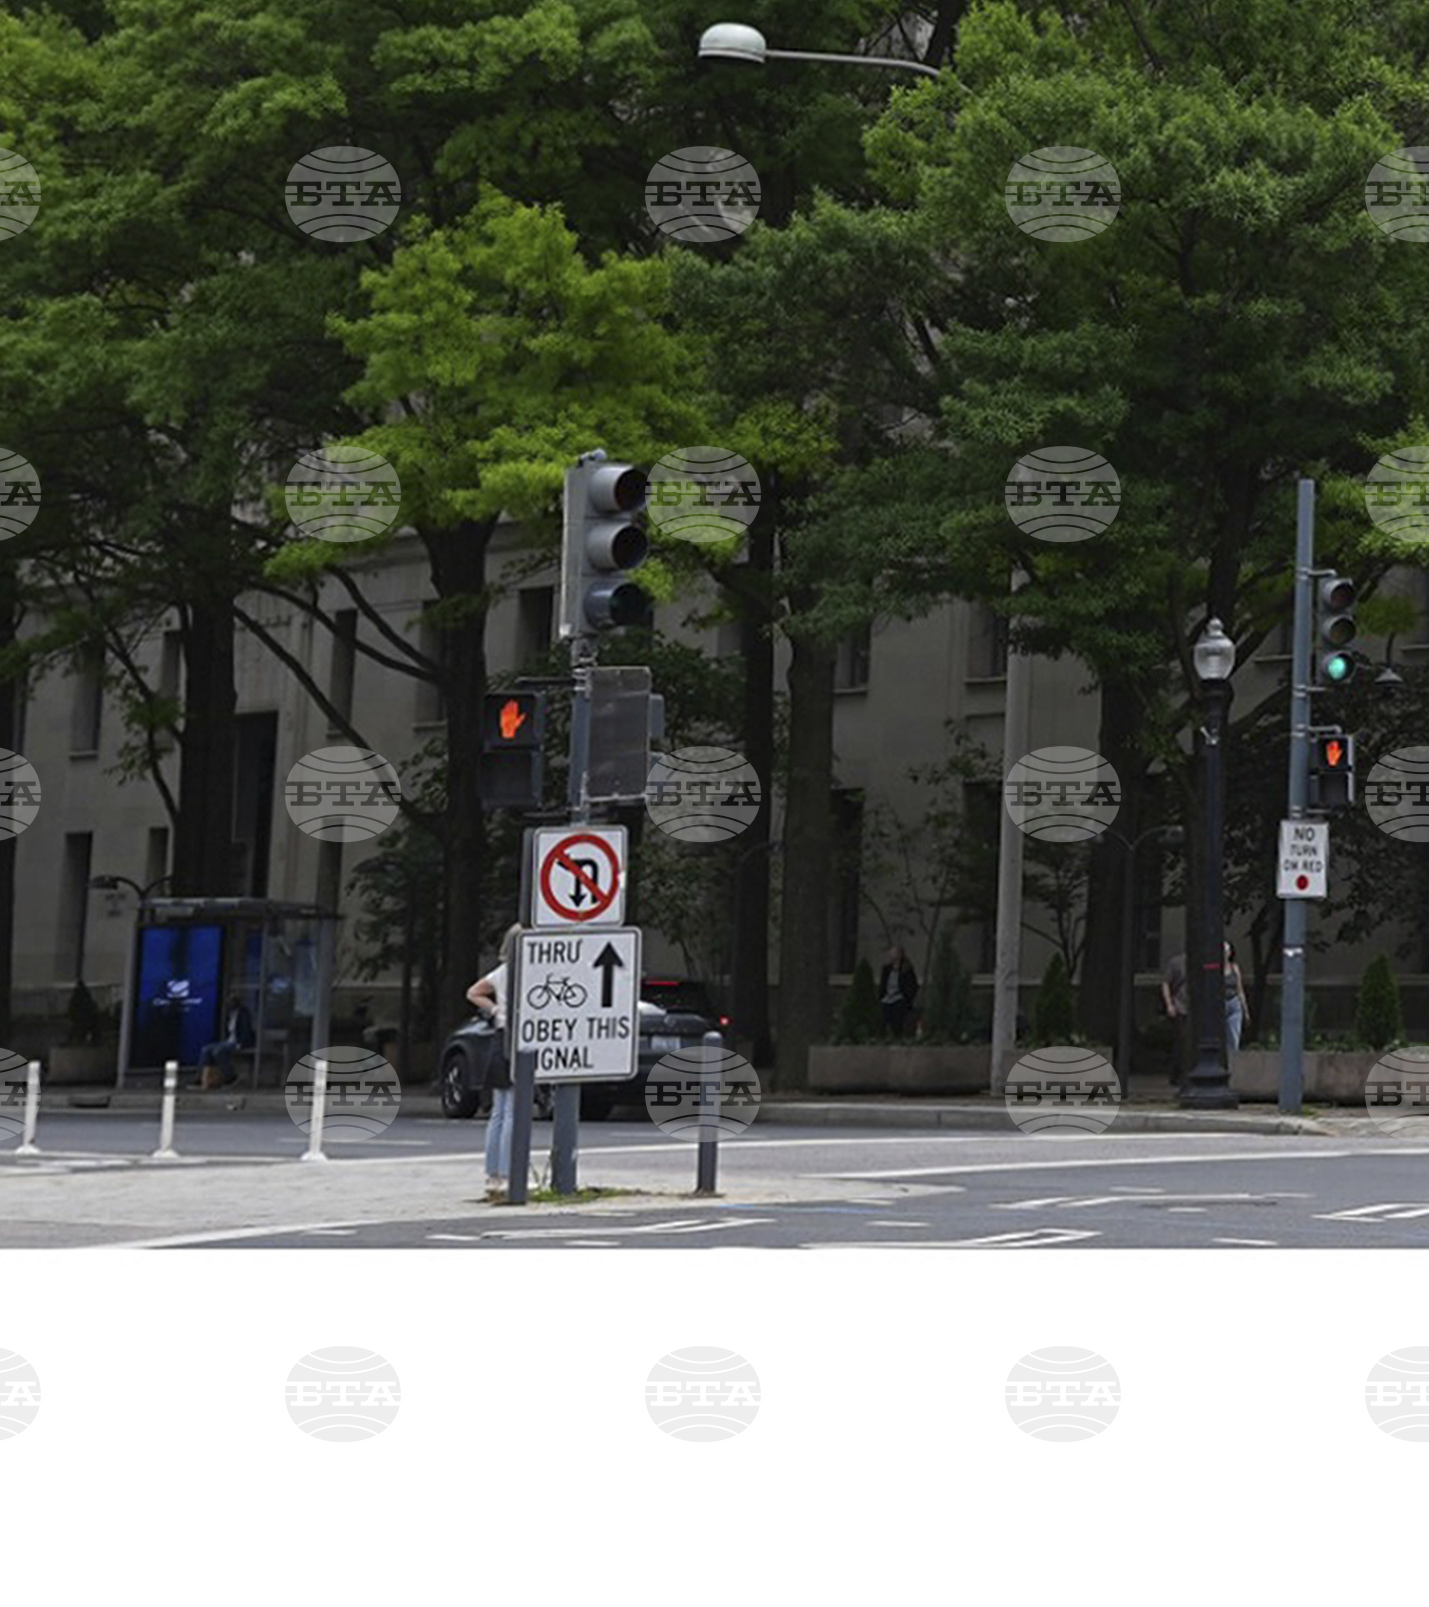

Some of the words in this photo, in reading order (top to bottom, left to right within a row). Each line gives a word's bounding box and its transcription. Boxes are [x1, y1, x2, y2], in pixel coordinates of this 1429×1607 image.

[1294, 826, 1316, 842] NO
[1290, 844, 1318, 857] TURN
[1302, 860, 1323, 873] RED
[527, 938, 583, 965] THRU
[522, 1017, 578, 1043] OBEY
[586, 1016, 630, 1040] THIS
[534, 1045, 595, 1072] IGNAL
